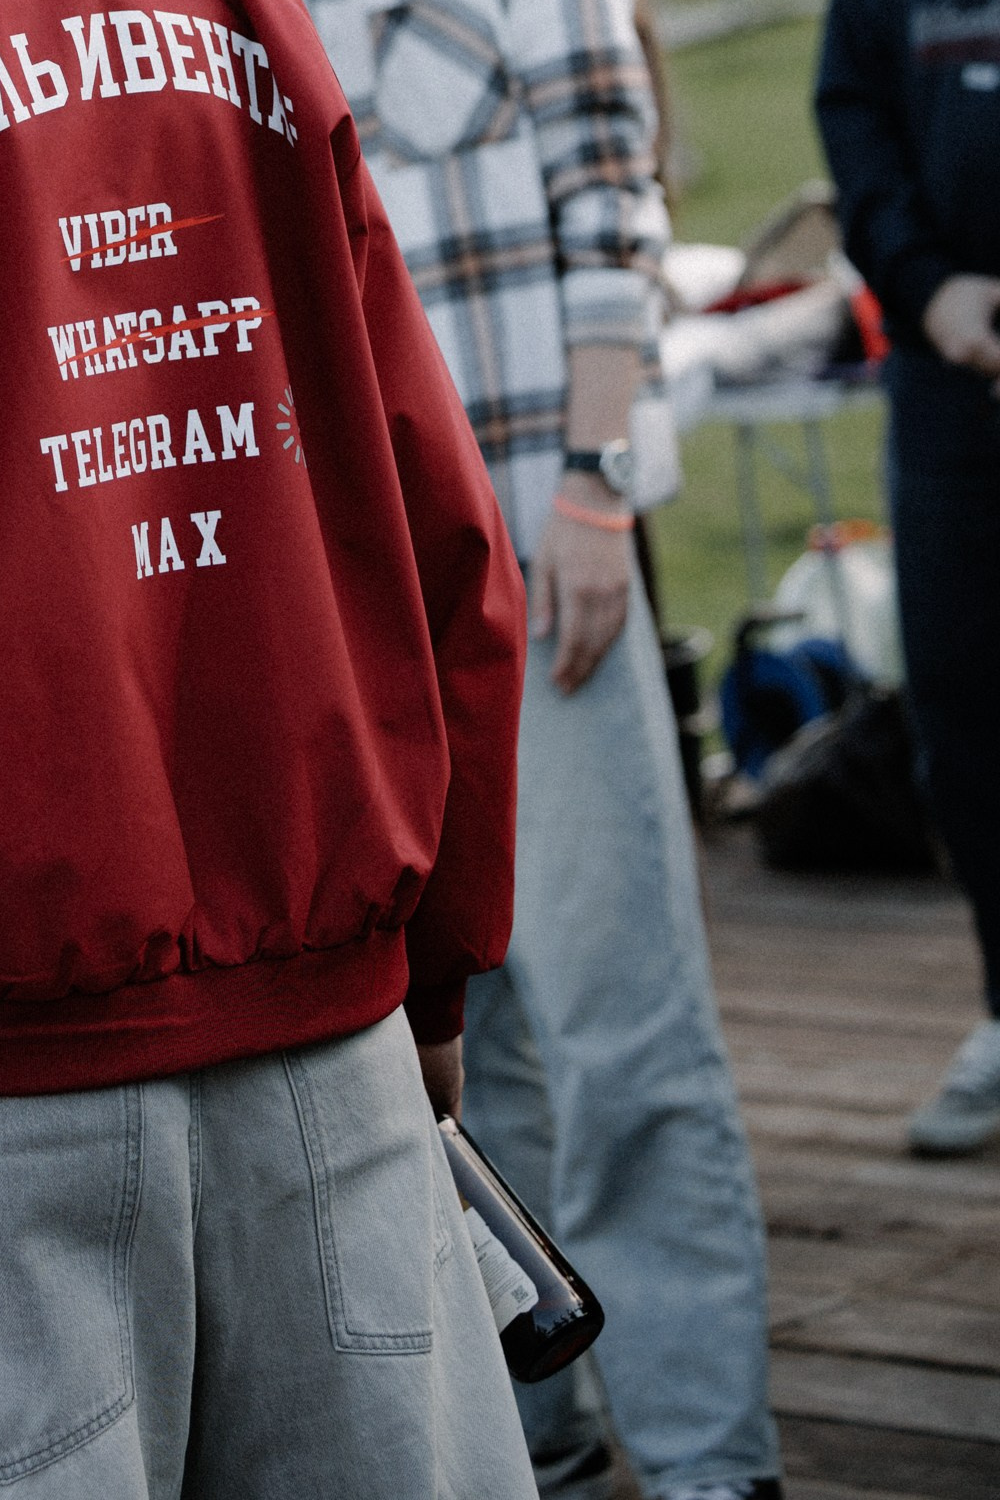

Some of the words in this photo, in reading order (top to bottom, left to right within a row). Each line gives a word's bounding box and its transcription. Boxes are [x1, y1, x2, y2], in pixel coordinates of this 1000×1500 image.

[58, 202, 178, 272] VIBER
[47, 296, 263, 381] WHATSAPP
[39, 401, 260, 493] TELEGRAM
[131, 509, 227, 580] MAX
